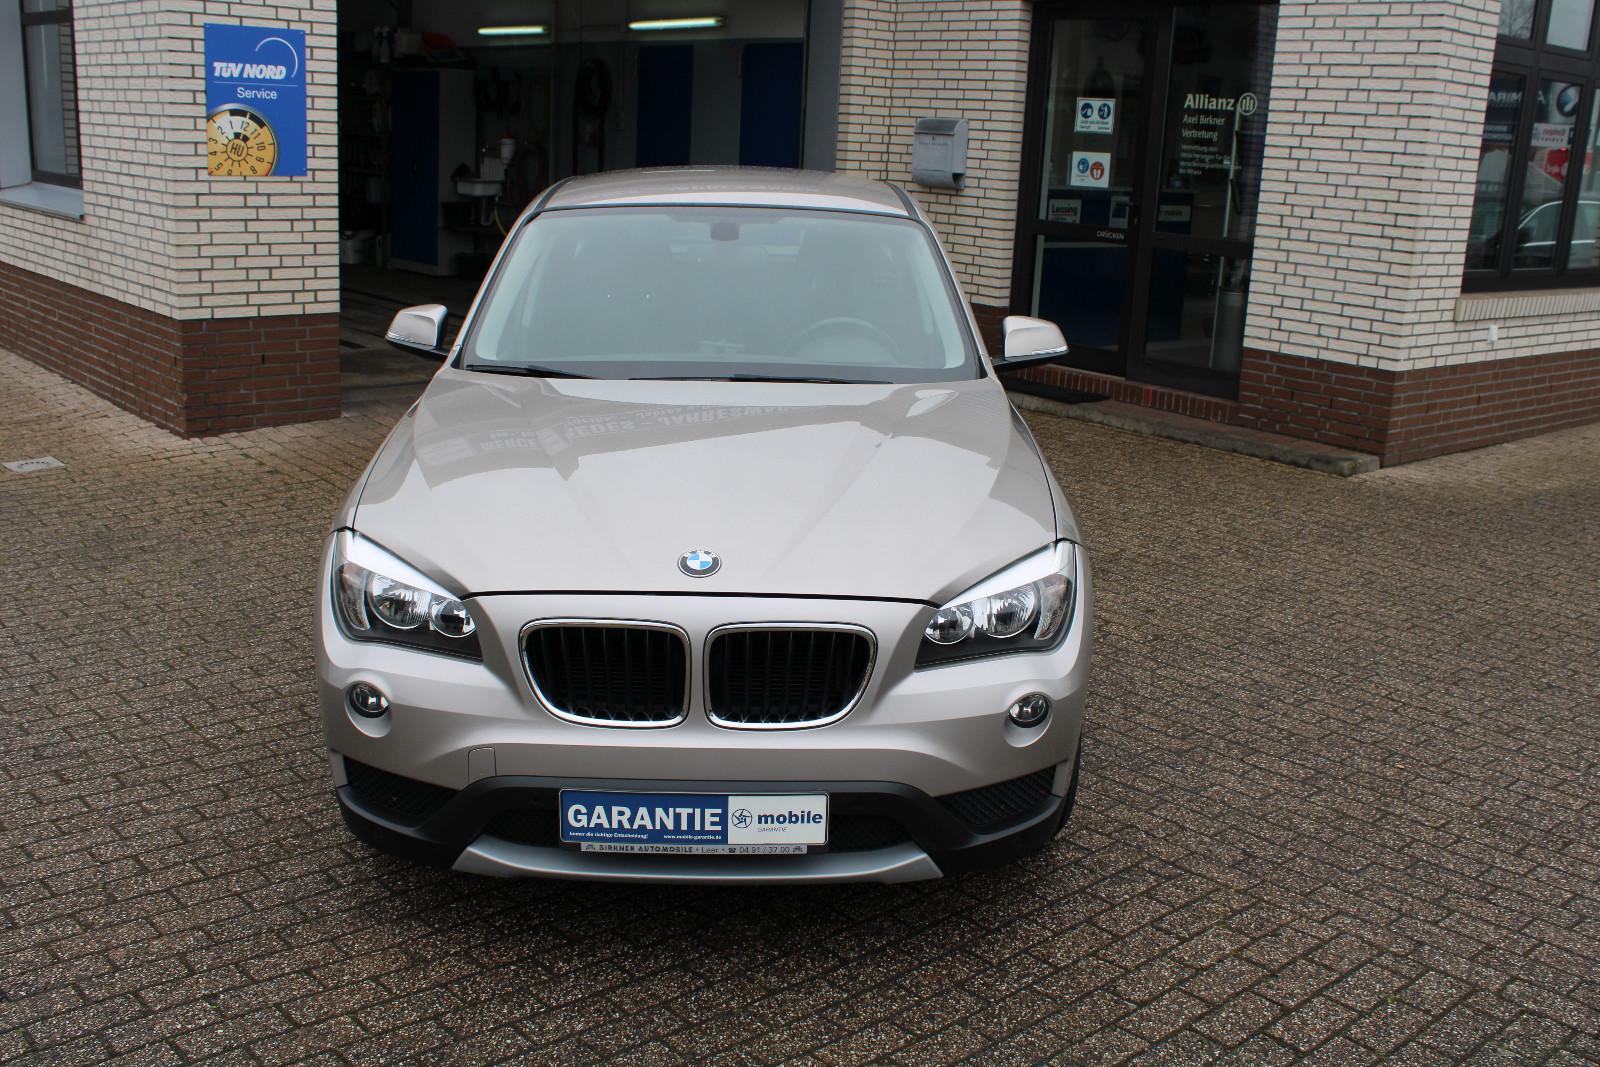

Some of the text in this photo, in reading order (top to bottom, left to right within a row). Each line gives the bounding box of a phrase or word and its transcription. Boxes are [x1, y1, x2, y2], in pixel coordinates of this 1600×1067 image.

[213, 62, 286, 79] TÜV NORD
[237, 87, 277, 99] Service
[1184, 93, 1235, 110] Allianz
[240, 120, 250, 132] 12
[1183, 114, 1225, 126] Axel Birkner
[217, 125, 226, 135] 2
[1182, 127, 1218, 142] Vertretung
[229, 142, 245, 158] HU
[1096, 230, 1125, 240] DRÜCKEN
[567, 804, 823, 831] GARANTIE mobile
